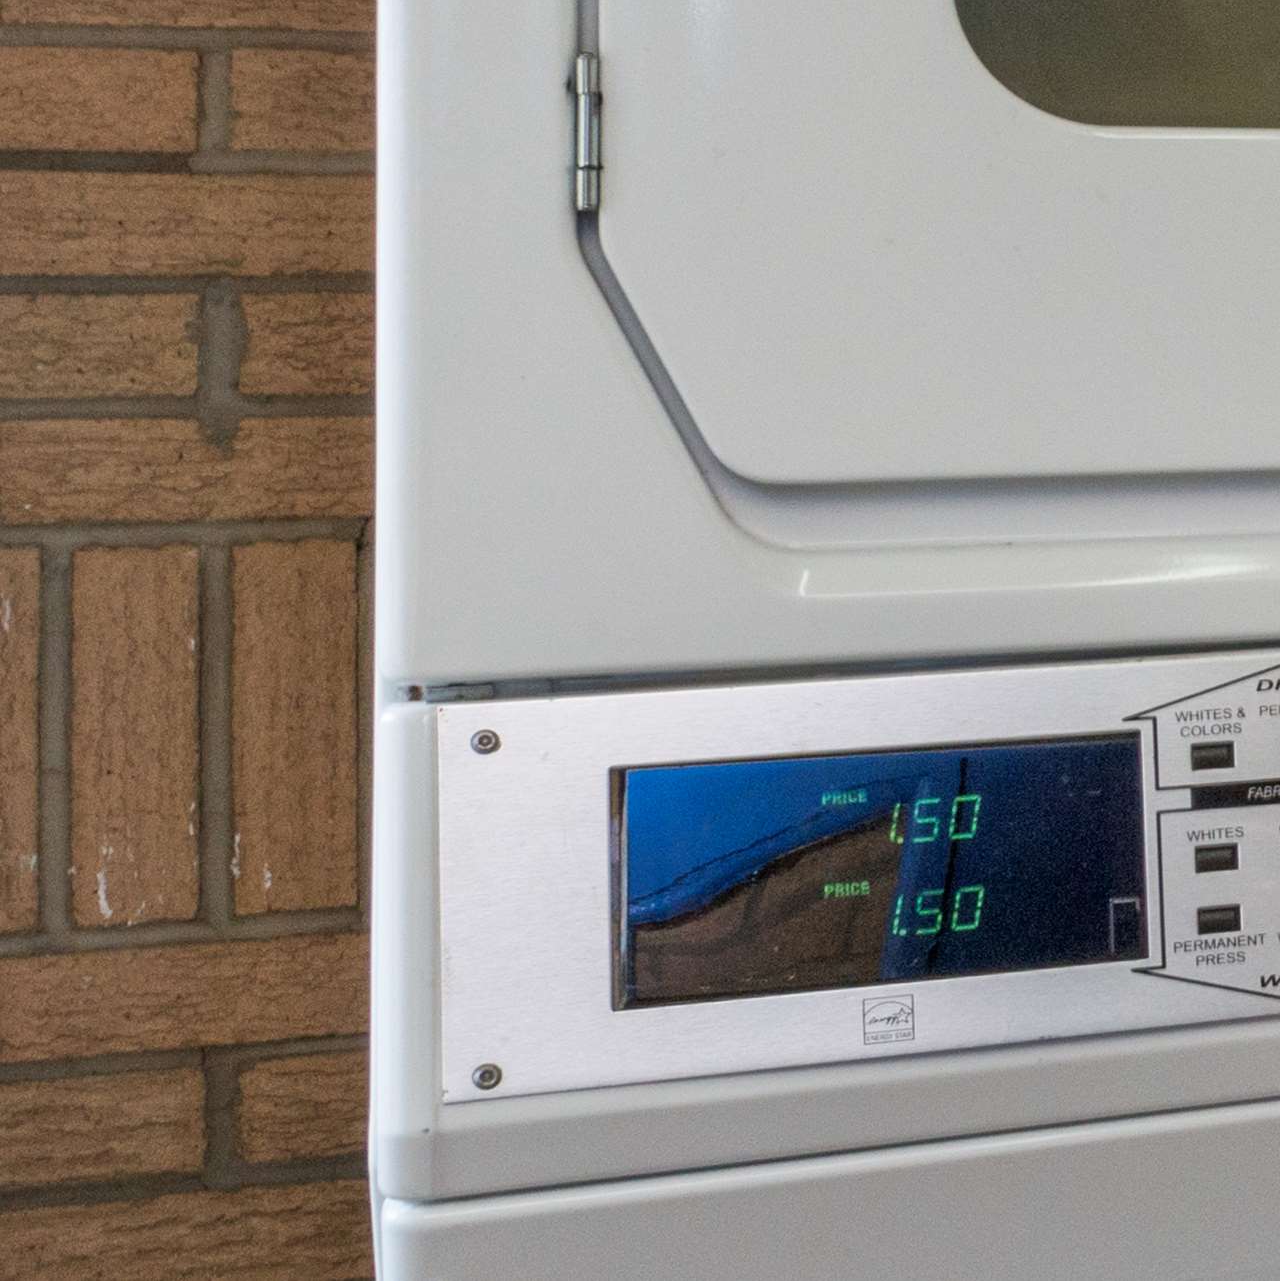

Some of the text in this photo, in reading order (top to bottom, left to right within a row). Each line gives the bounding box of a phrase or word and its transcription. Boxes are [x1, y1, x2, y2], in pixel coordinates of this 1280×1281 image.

[1174, 707, 1247, 724] WHITES &
[1180, 722, 1243, 738] COLORS
[821, 789, 868, 806] PRICE
[888, 793, 983, 845] 1.50
[1187, 826, 1245, 842] WHITES
[823, 878, 871, 899] PRICE
[891, 882, 986, 938] 1.50
[1173, 932, 1267, 954] PERMANENT
[1195, 951, 1247, 967] PRESS
